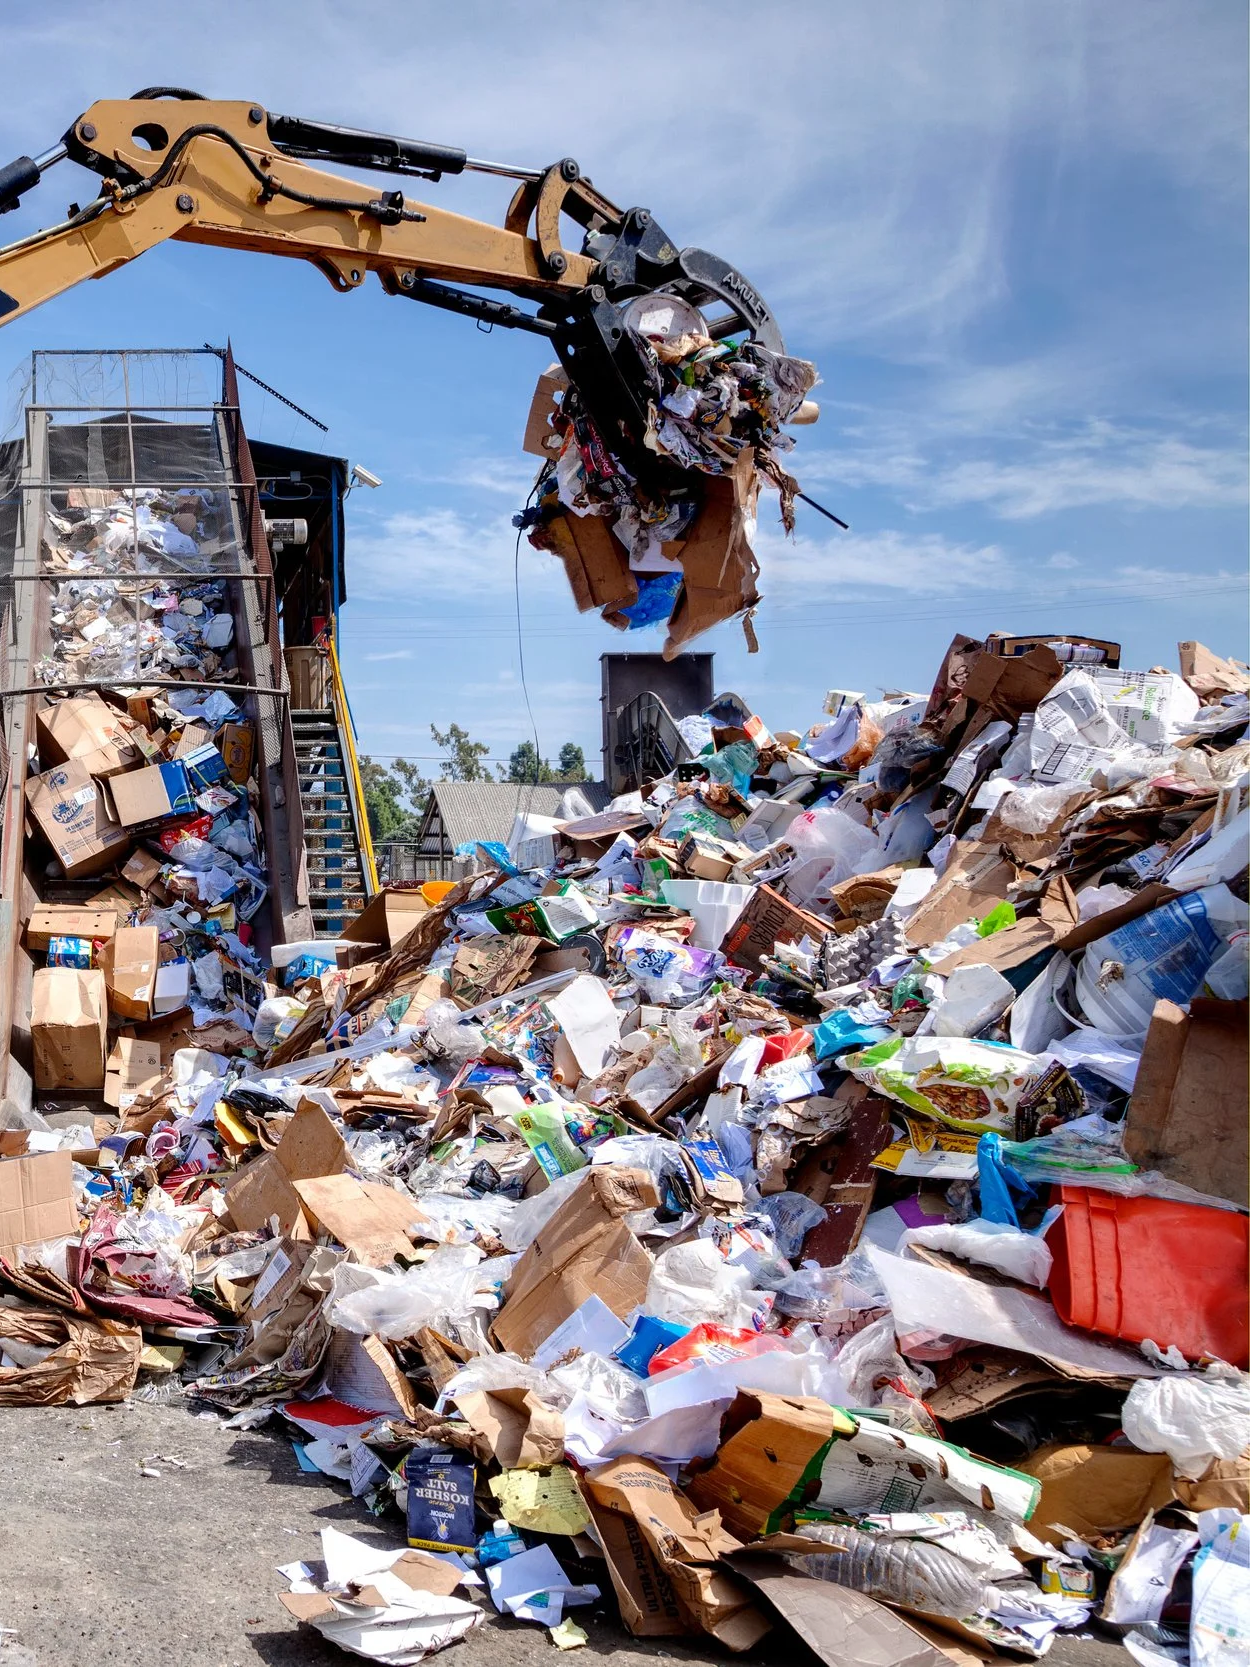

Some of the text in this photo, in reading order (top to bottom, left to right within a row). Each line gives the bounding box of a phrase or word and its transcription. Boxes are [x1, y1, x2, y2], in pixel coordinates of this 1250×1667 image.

[722, 270, 771, 325] AMULET
[1141, 687, 1157, 721] Reliance
[749, 899, 791, 950] FLOWERS
[426, 1478, 458, 1493] SALT
[414, 1487, 470, 1506] KOSHER
[429, 1509, 455, 1520] MORTON
[416, 1540, 431, 1548] PACK
